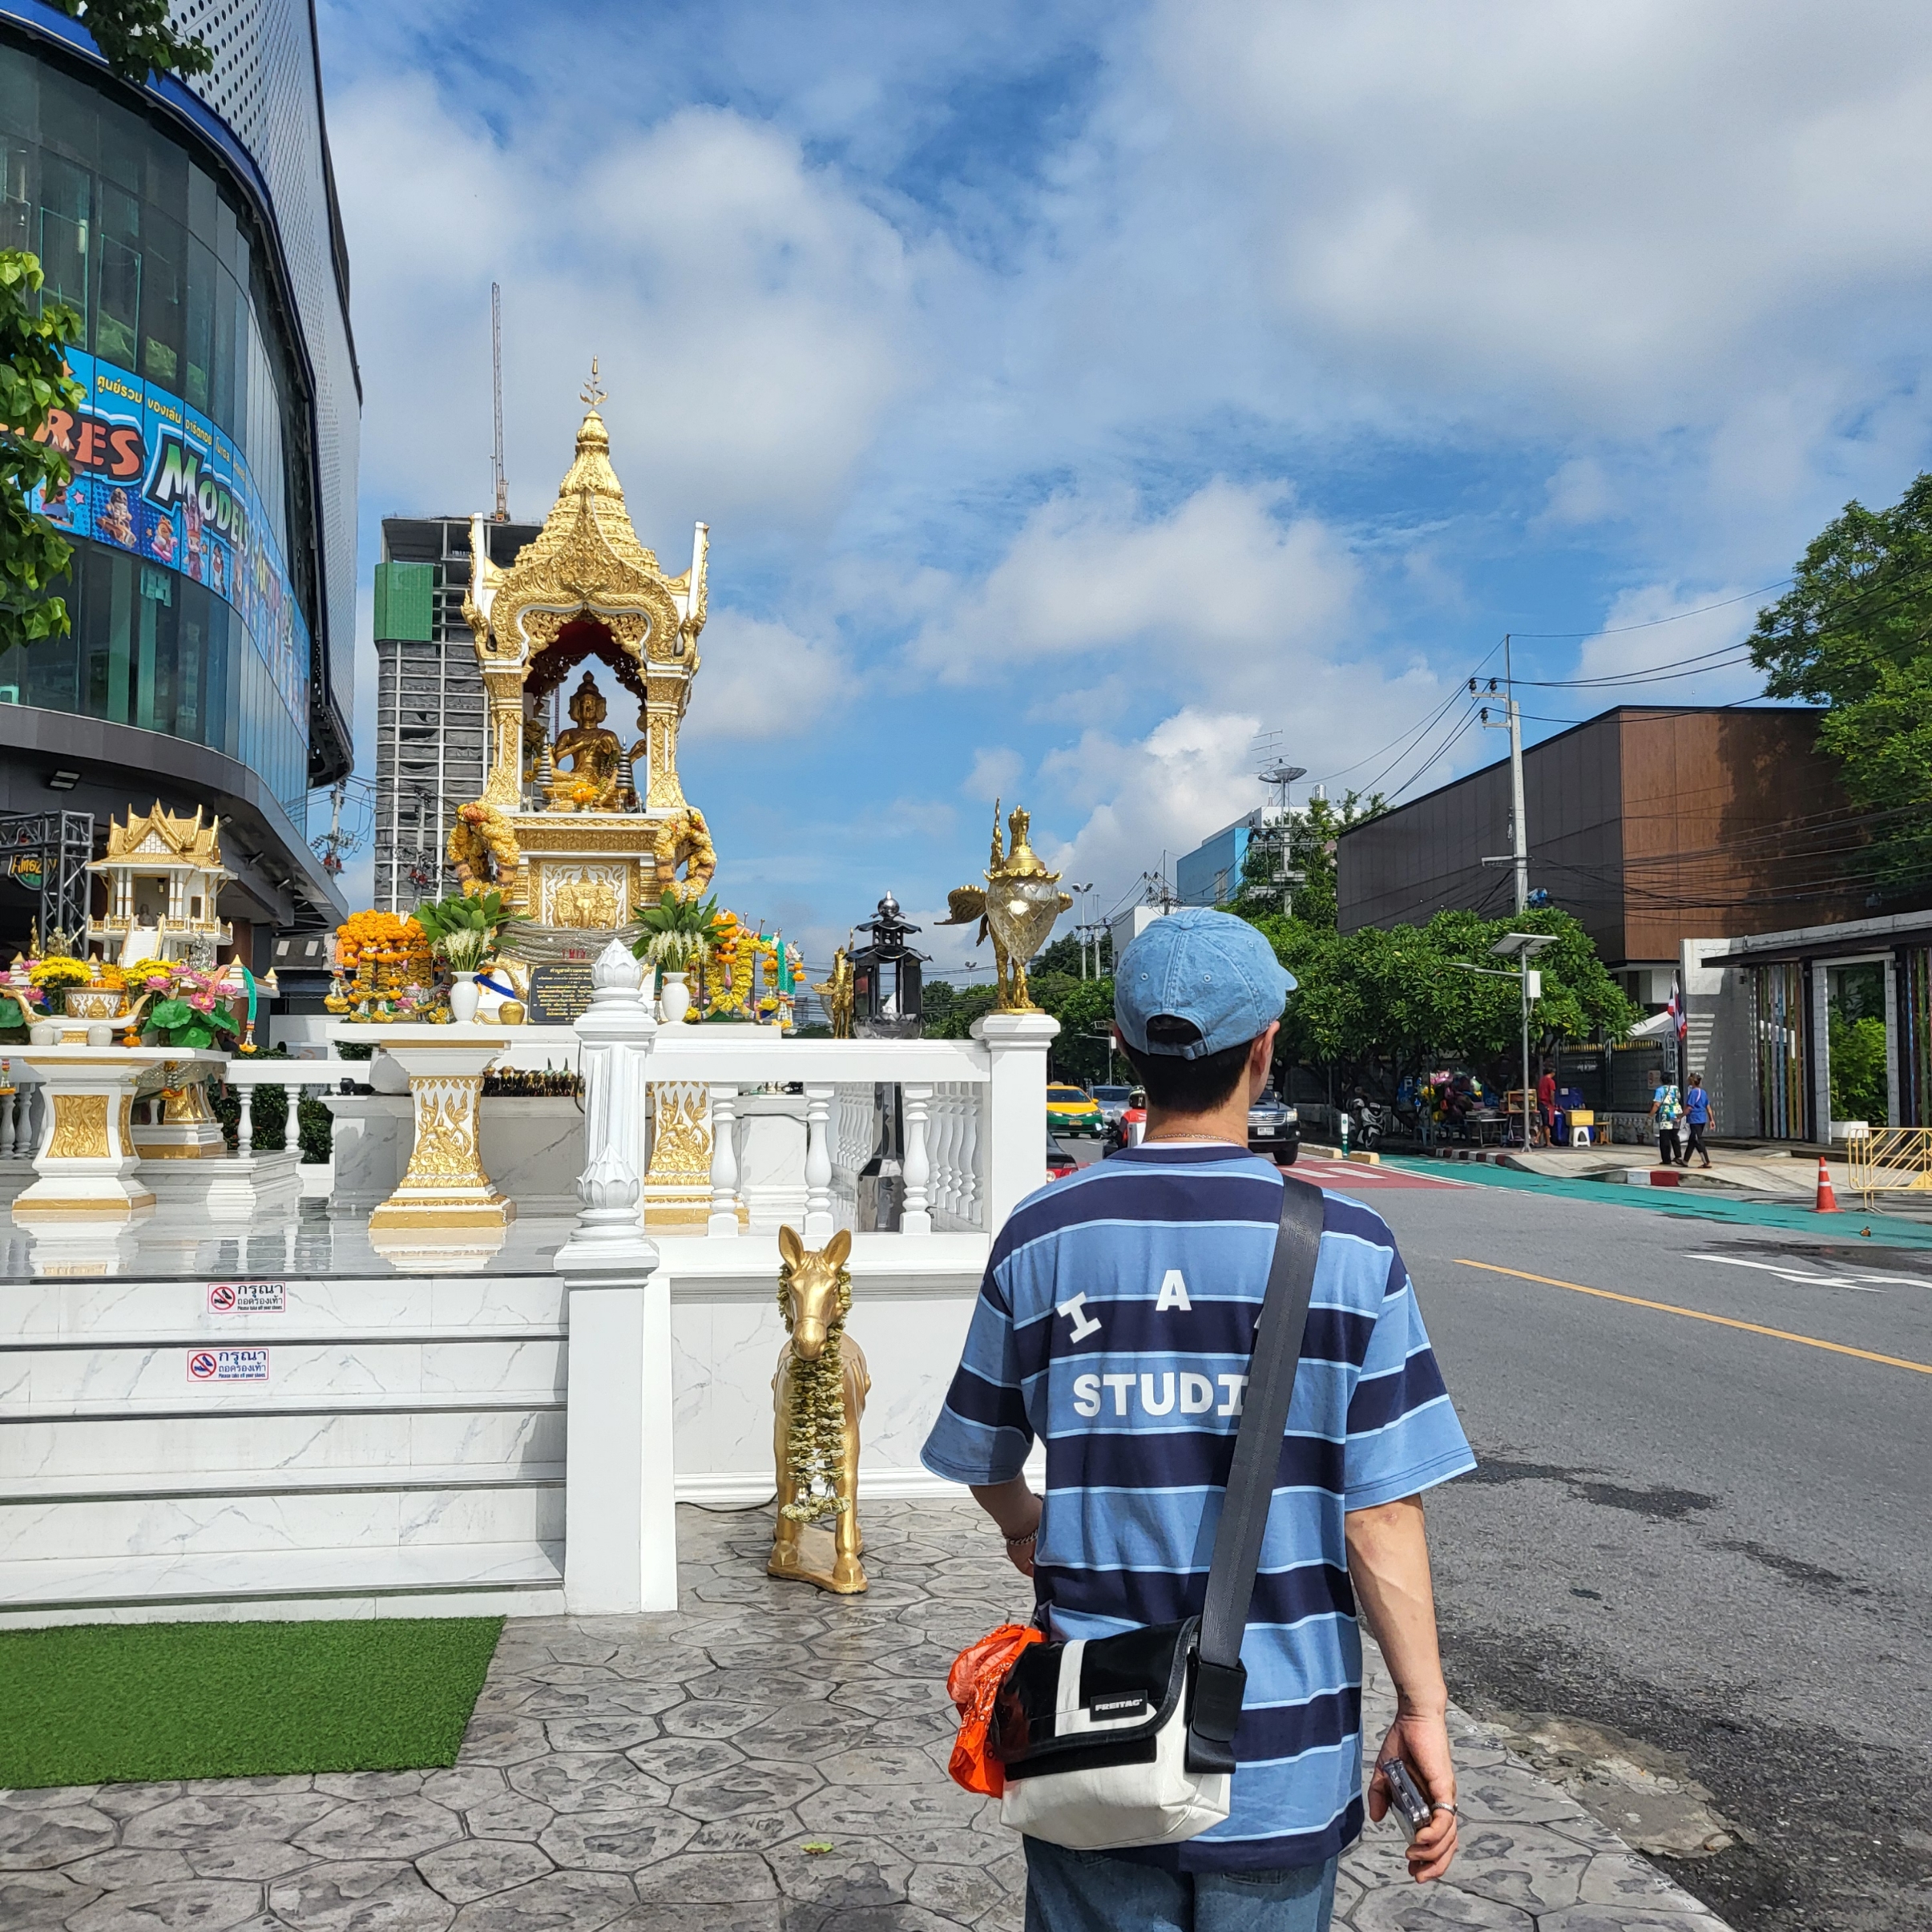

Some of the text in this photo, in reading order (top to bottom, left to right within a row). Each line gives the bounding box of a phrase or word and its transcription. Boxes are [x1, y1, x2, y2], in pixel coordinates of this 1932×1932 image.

[97, 375, 143, 404] ศูนย์รวม
[147, 397, 181, 424] ของเล่น
[237, 1285, 283, 1298] กรุณา
[237, 1295, 283, 1305] ถอดรองเท้า
[1056, 1269, 1192, 1344] I A
[219, 1350, 266, 1365] กรุณา
[219, 1361, 266, 1372] ถอดรองเท้า
